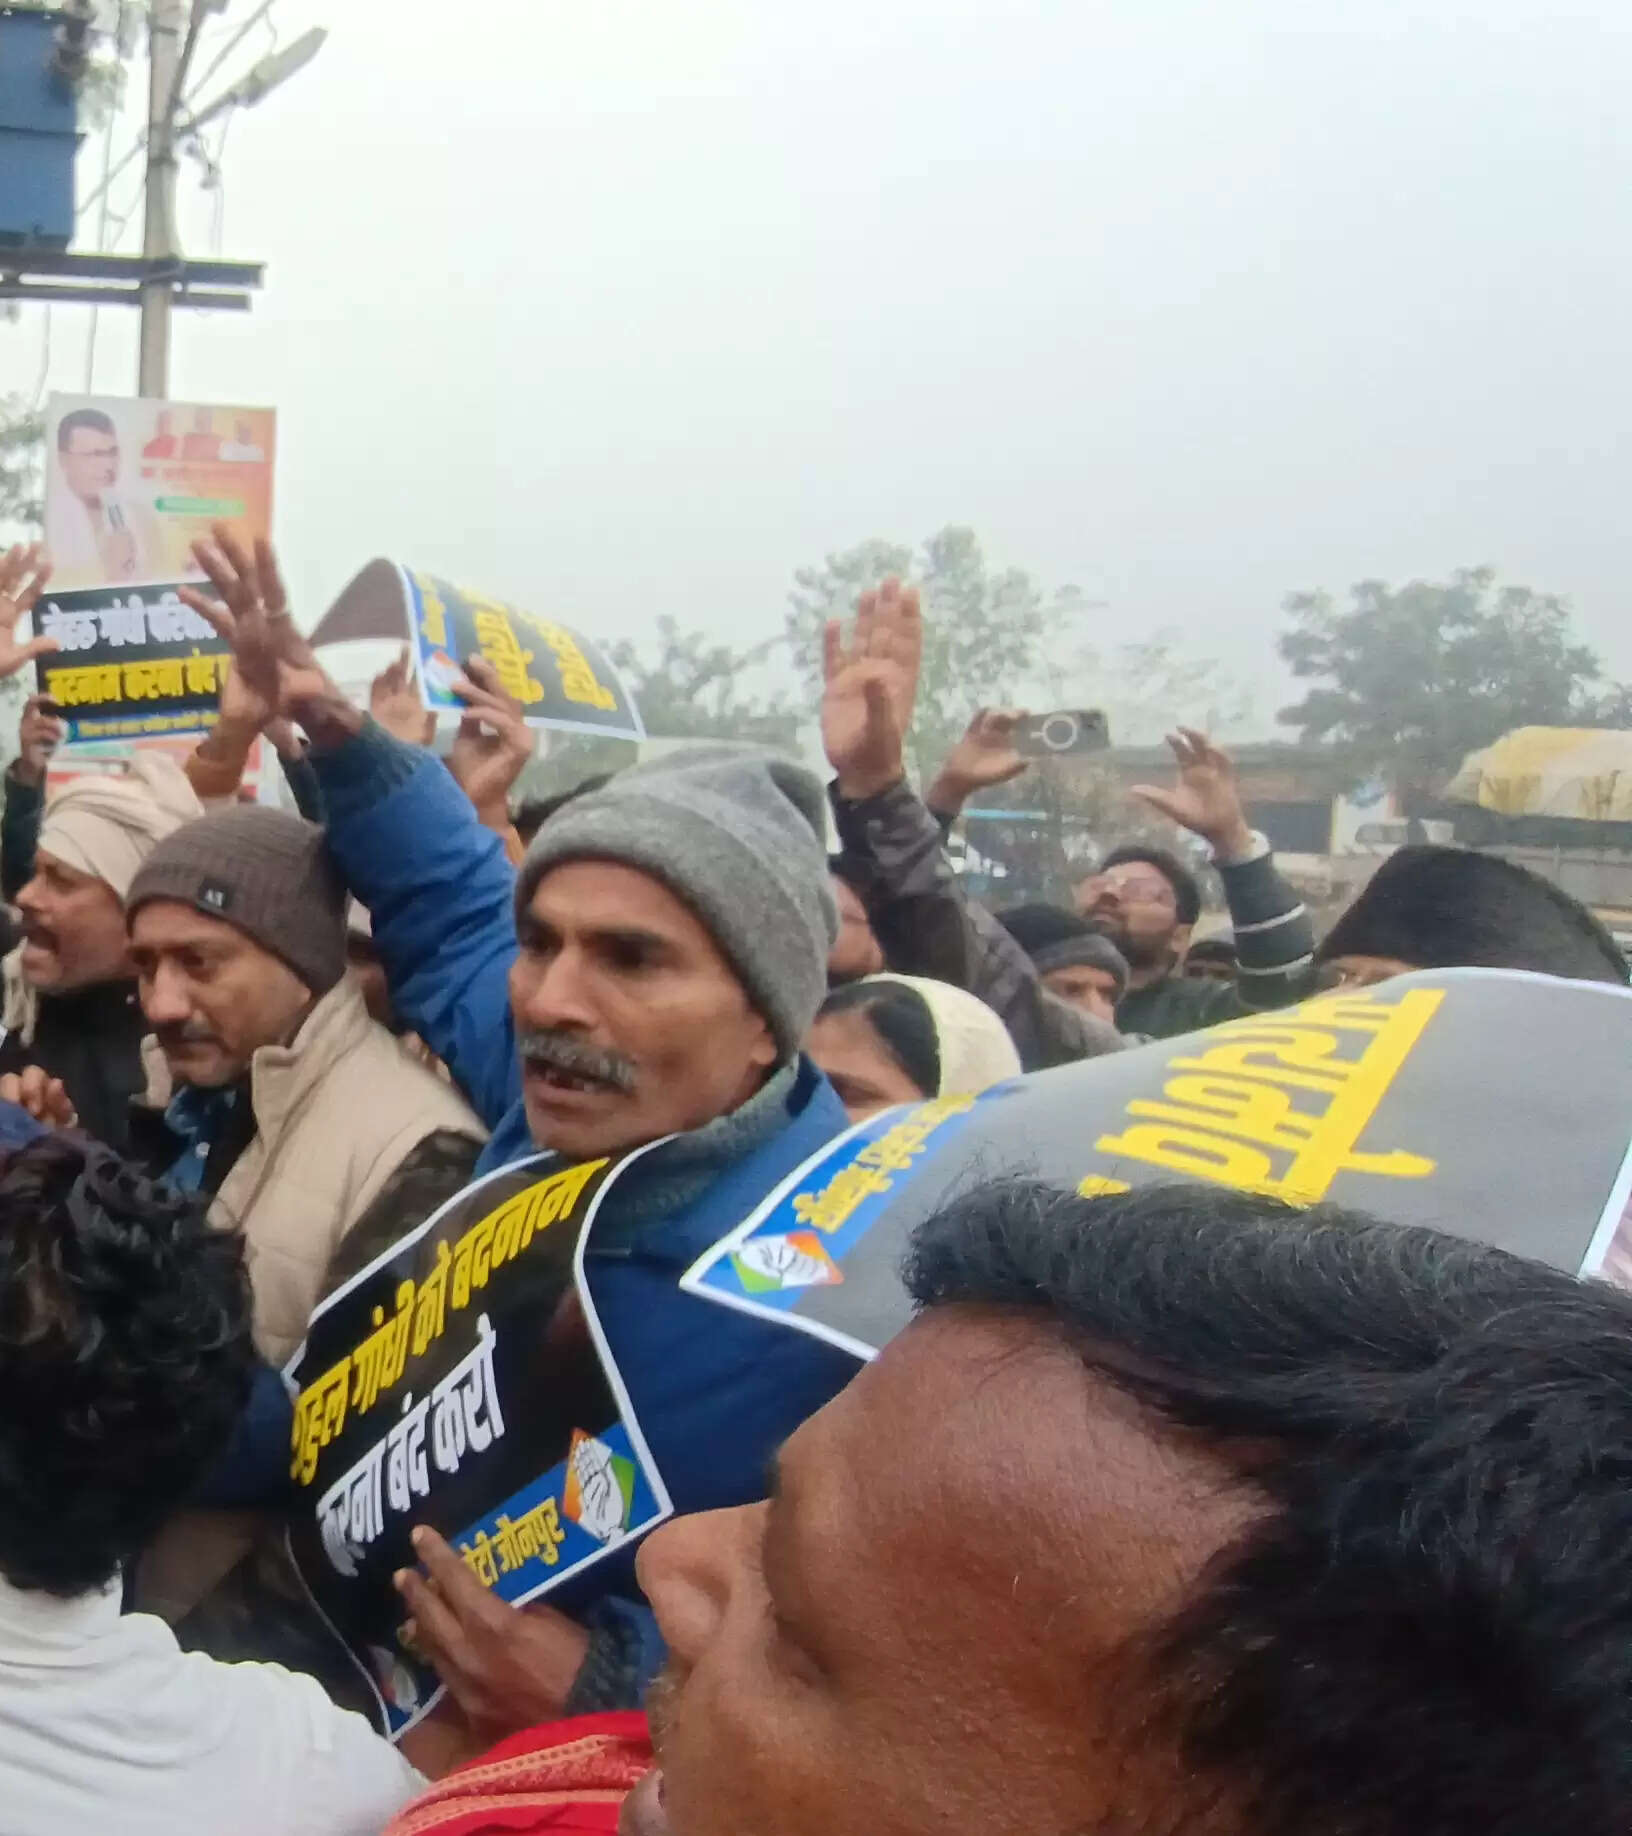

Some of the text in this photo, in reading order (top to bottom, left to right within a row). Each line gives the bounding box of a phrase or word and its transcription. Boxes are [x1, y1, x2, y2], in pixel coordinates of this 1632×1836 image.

[352, 1279, 415, 1415] गांधी
[412, 1240, 452, 1356] को
[452, 1157, 610, 1309] बदनाम
[316, 1312, 505, 1577] करना बंद करो
[492, 1496, 565, 1565] जौनपुर
